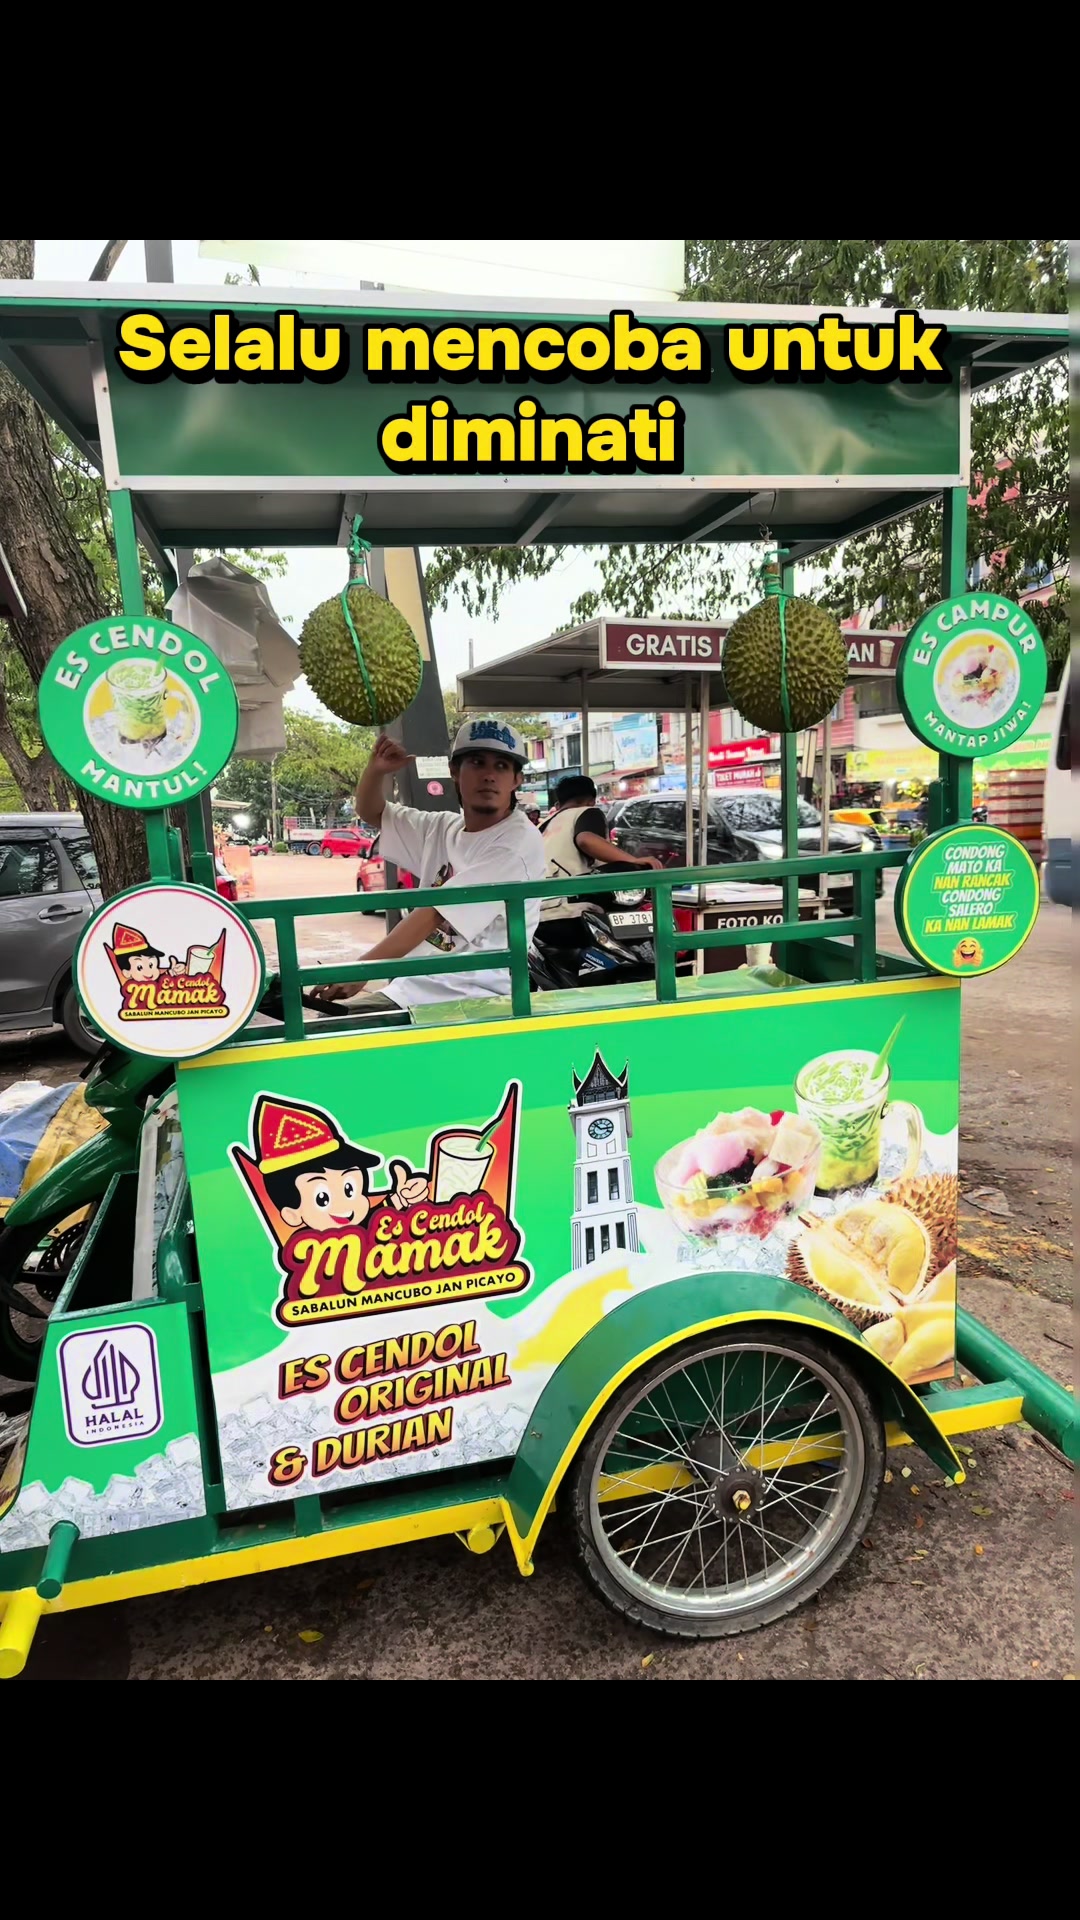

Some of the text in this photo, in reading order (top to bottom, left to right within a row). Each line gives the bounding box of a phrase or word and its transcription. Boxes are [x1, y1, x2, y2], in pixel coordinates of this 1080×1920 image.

[626, 633, 712, 657] GRATIS
[913, 600, 1037, 666] ES CAMPUR
[55, 624, 220, 693] ES CENDOL
[924, 700, 1032, 747] MANTAP JIWA!
[80, 759, 208, 799] MANTUL!
[945, 844, 1005, 861] CONDONG
[947, 859, 1002, 874] MATO KA
[933, 872, 1010, 890] NAN RANCAK
[942, 888, 1001, 904] CONDONG
[612, 915, 624, 925] BP
[948, 902, 993, 918] SALERO
[717, 915, 757, 930] FOTO
[925, 914, 1014, 933] KA NAN LAMAK
[162, 977, 210, 989] Es Cendol
[126, 982, 221, 1010] Mamak
[375, 1200, 485, 1243] Es Cendol
[293, 1211, 508, 1298] Mamak
[292, 1271, 516, 1316] SABALUN MANCUBO JAN PICAYO
[279, 1320, 480, 1399] ES CENDOL
[335, 1353, 511, 1425] ORIGINAL
[85, 1408, 144, 1427] HALAL
[86, 1421, 145, 1434] INDONESIA
[269, 1407, 453, 1486] & DURIAN
